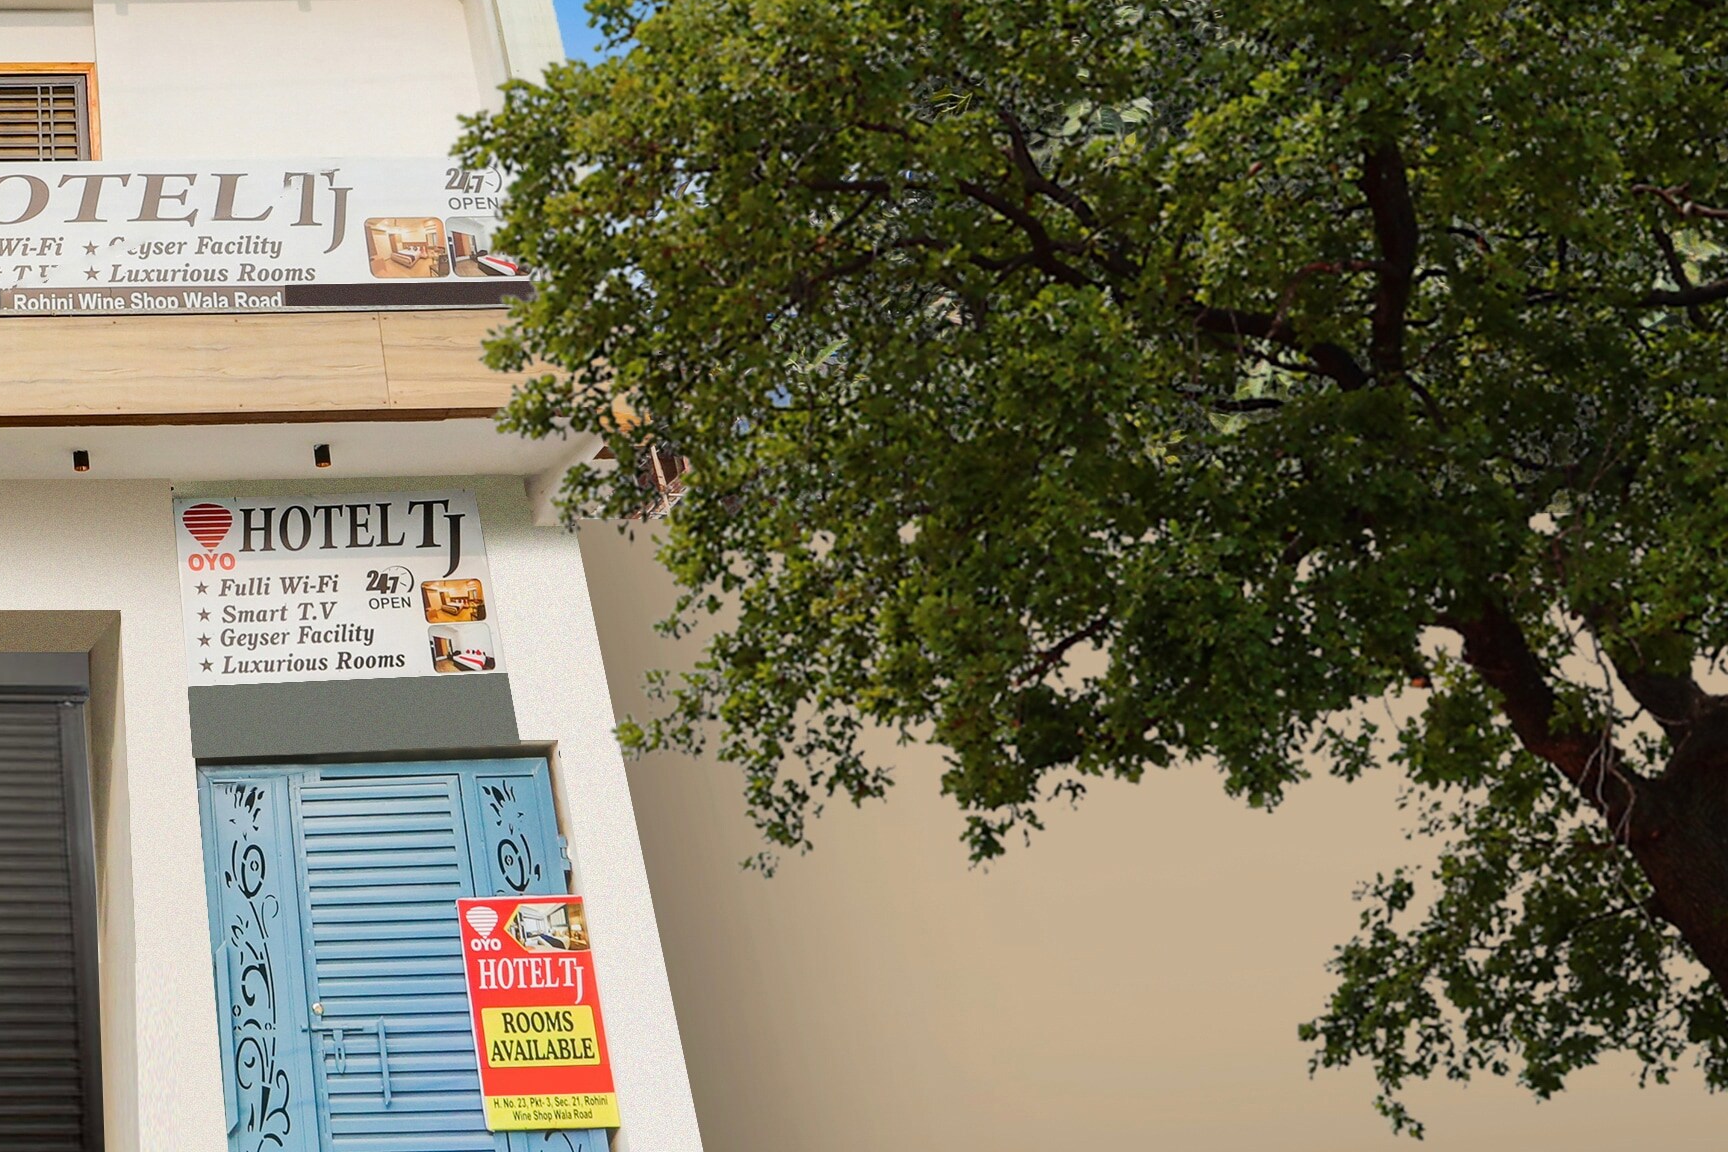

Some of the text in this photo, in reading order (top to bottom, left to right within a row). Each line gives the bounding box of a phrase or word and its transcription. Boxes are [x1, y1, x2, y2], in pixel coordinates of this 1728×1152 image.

[283, 169, 354, 254] TJ
[448, 197, 499, 210] OPEN
[194, 235, 283, 260] Facility
[108, 263, 229, 283] Luxurious
[236, 262, 316, 282] Rooms
[13, 293, 73, 310] Rohini
[78, 292, 125, 309] Wine
[130, 292, 179, 309] Shop
[183, 292, 229, 309] Wala
[234, 291, 283, 309] Road
[239, 499, 466, 578] HOTEL TJ
[187, 552, 236, 572] OYO
[218, 573, 339, 597] Fulli Wi-Fi
[222, 601, 339, 624] Smart T.V
[368, 596, 412, 610] OPEN
[220, 623, 375, 651] Geyser Facility
[221, 650, 406, 675] Luxurious Rooms
[470, 938, 502, 952] OYO
[478, 957, 584, 1004] HOTEL TJ
[501, 1010, 574, 1034] ROOMS
[491, 1037, 596, 1062] AVAILABLE
[584, 1095, 609, 1106] Rohini
[513, 1108, 593, 1123] Wine Shop Wala Road
